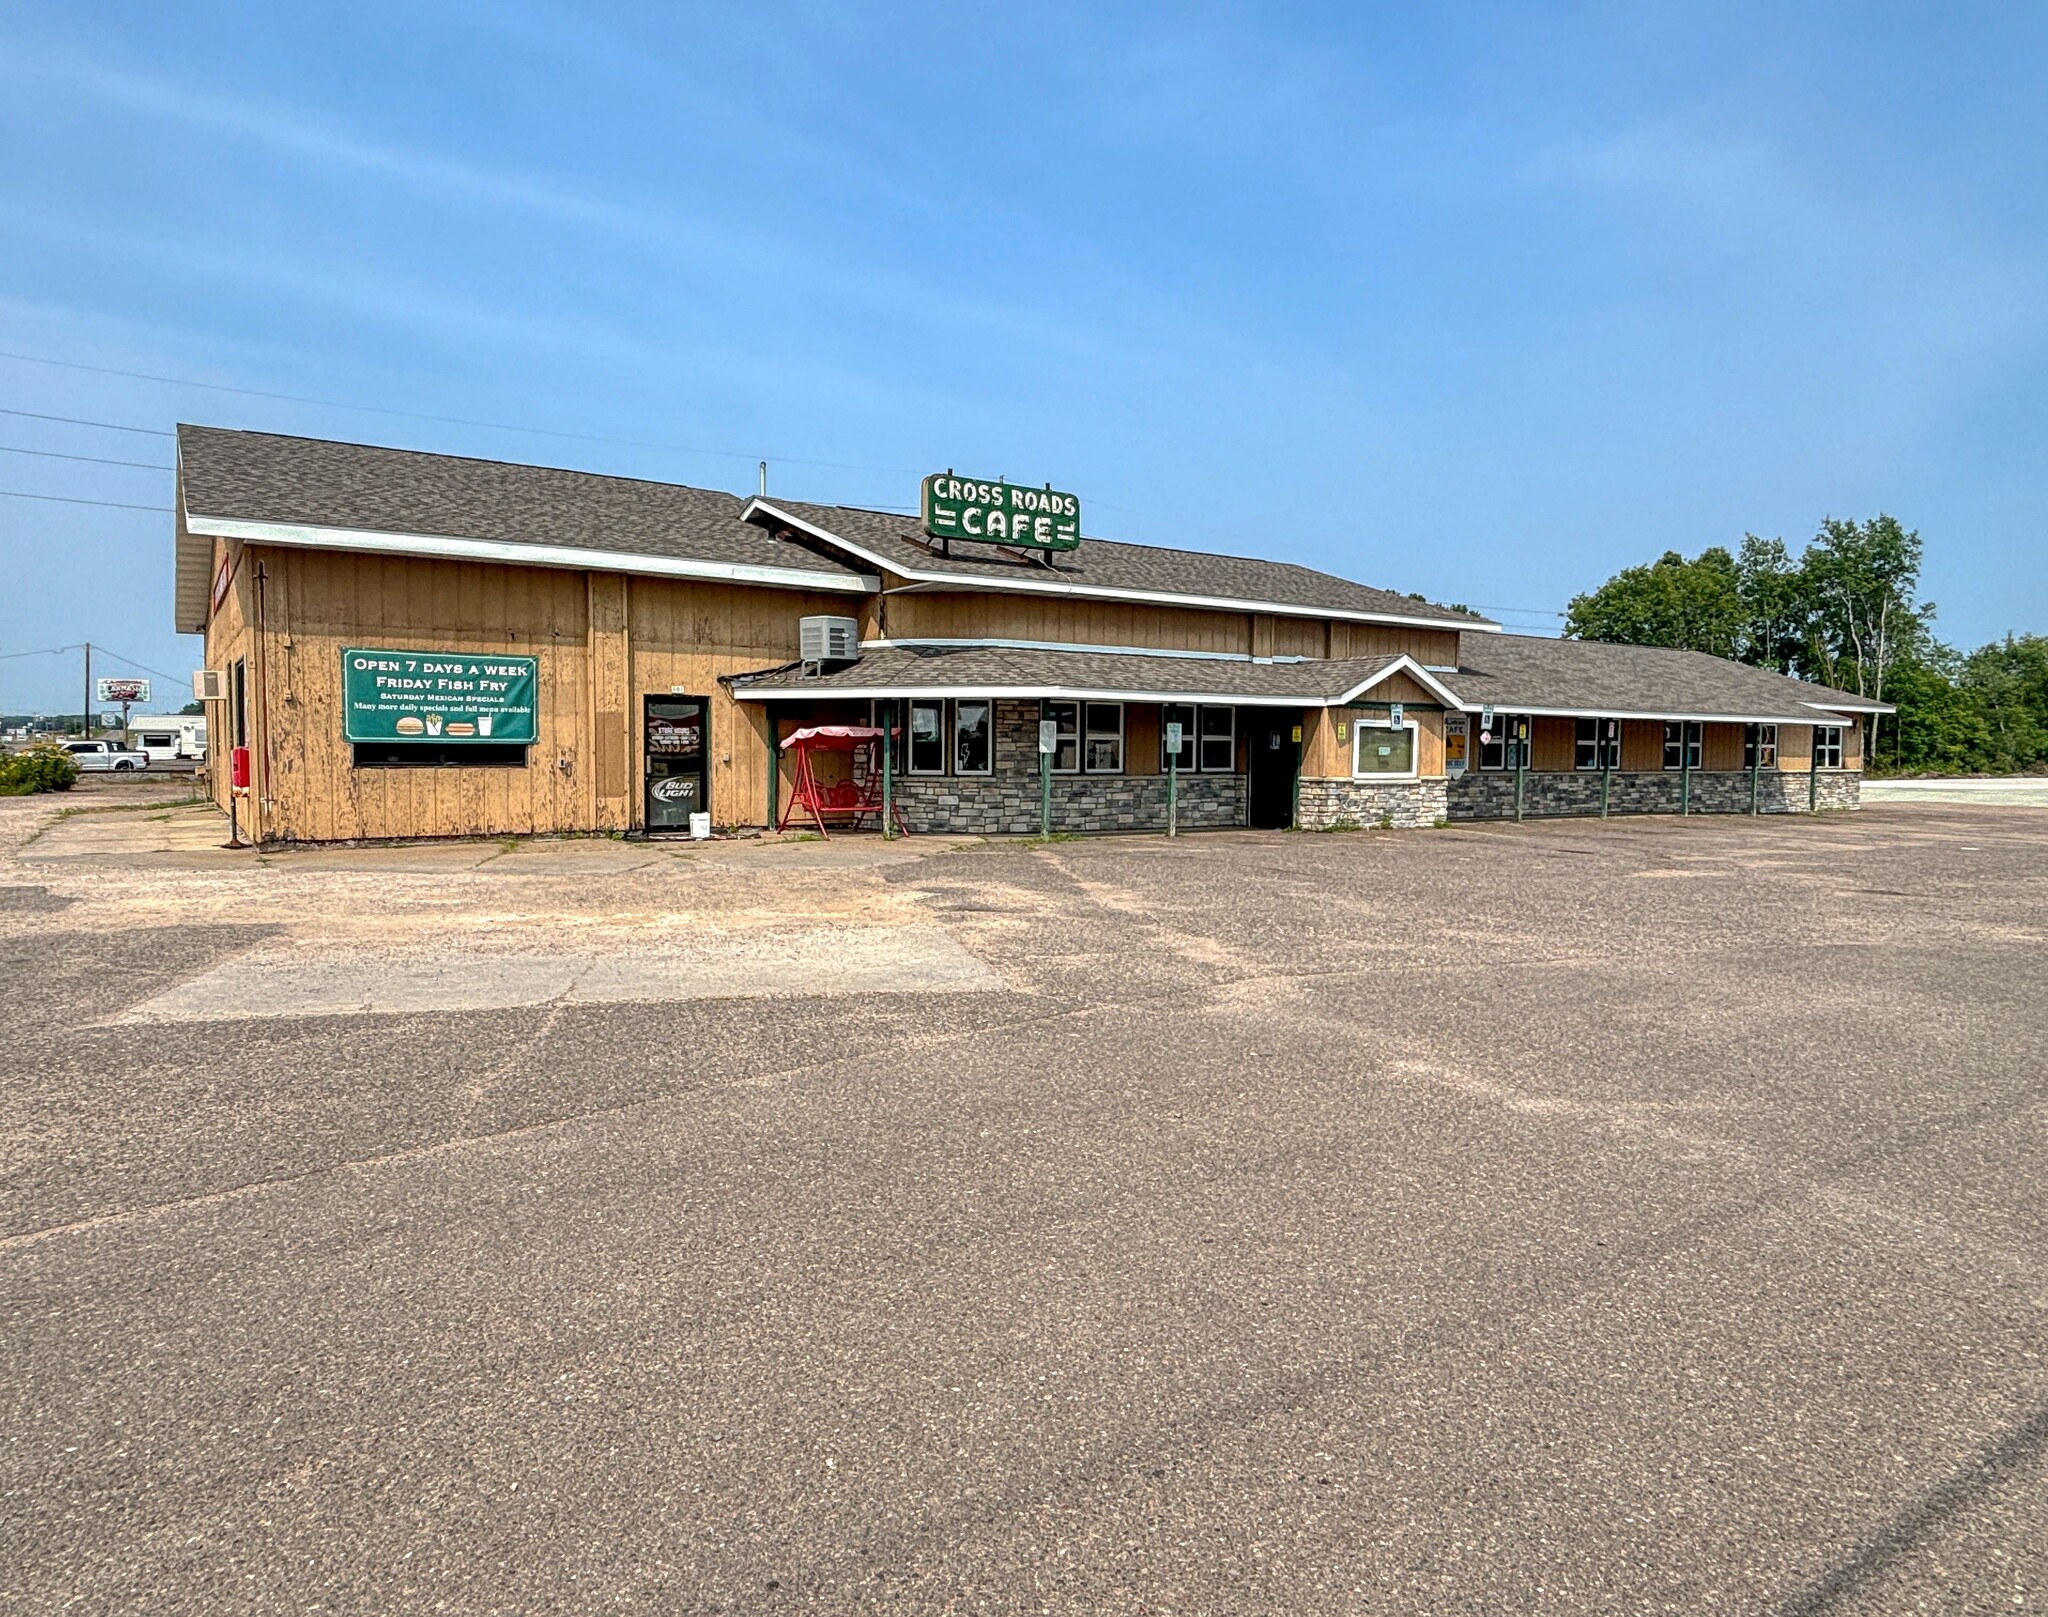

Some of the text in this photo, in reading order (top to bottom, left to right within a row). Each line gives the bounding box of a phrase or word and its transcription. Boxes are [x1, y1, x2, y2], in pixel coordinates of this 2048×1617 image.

[933, 478, 1076, 516] CROSS ROADS
[962, 507, 1052, 543] CAFE
[354, 658, 528, 676] OPEN 7 DAYS A WEEK
[376, 676, 508, 691] FRIDAY FISH FRY
[380, 692, 504, 703] SATURDAY MEXICAN SPECIALS
[354, 701, 376, 711] Many
[399, 703, 418, 712] daily
[420, 704, 448, 712] specials
[665, 781, 693, 789] BUD
